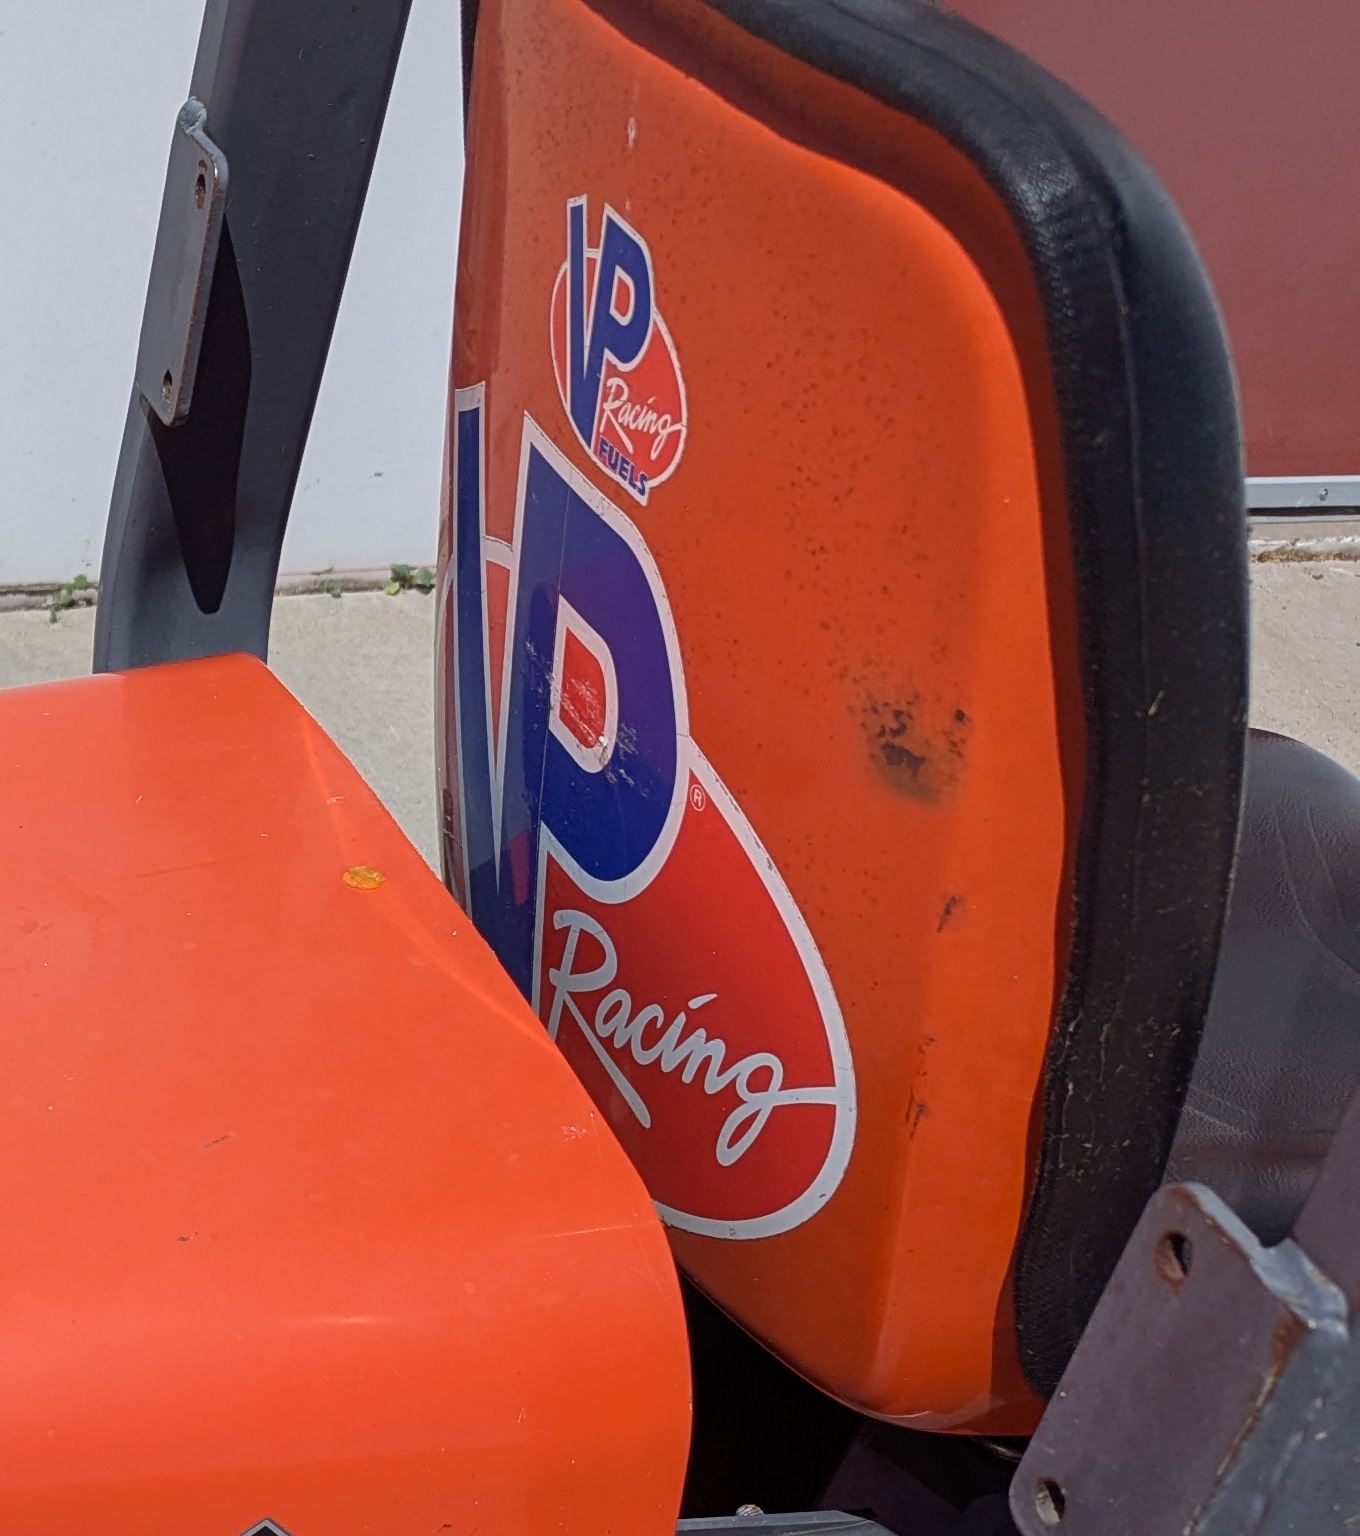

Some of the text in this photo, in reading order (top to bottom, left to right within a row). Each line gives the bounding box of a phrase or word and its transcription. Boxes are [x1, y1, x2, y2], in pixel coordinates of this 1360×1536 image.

[599, 377, 686, 460] Racing
[597, 435, 649, 498] FUELS
[549, 909, 836, 1168] Racing
